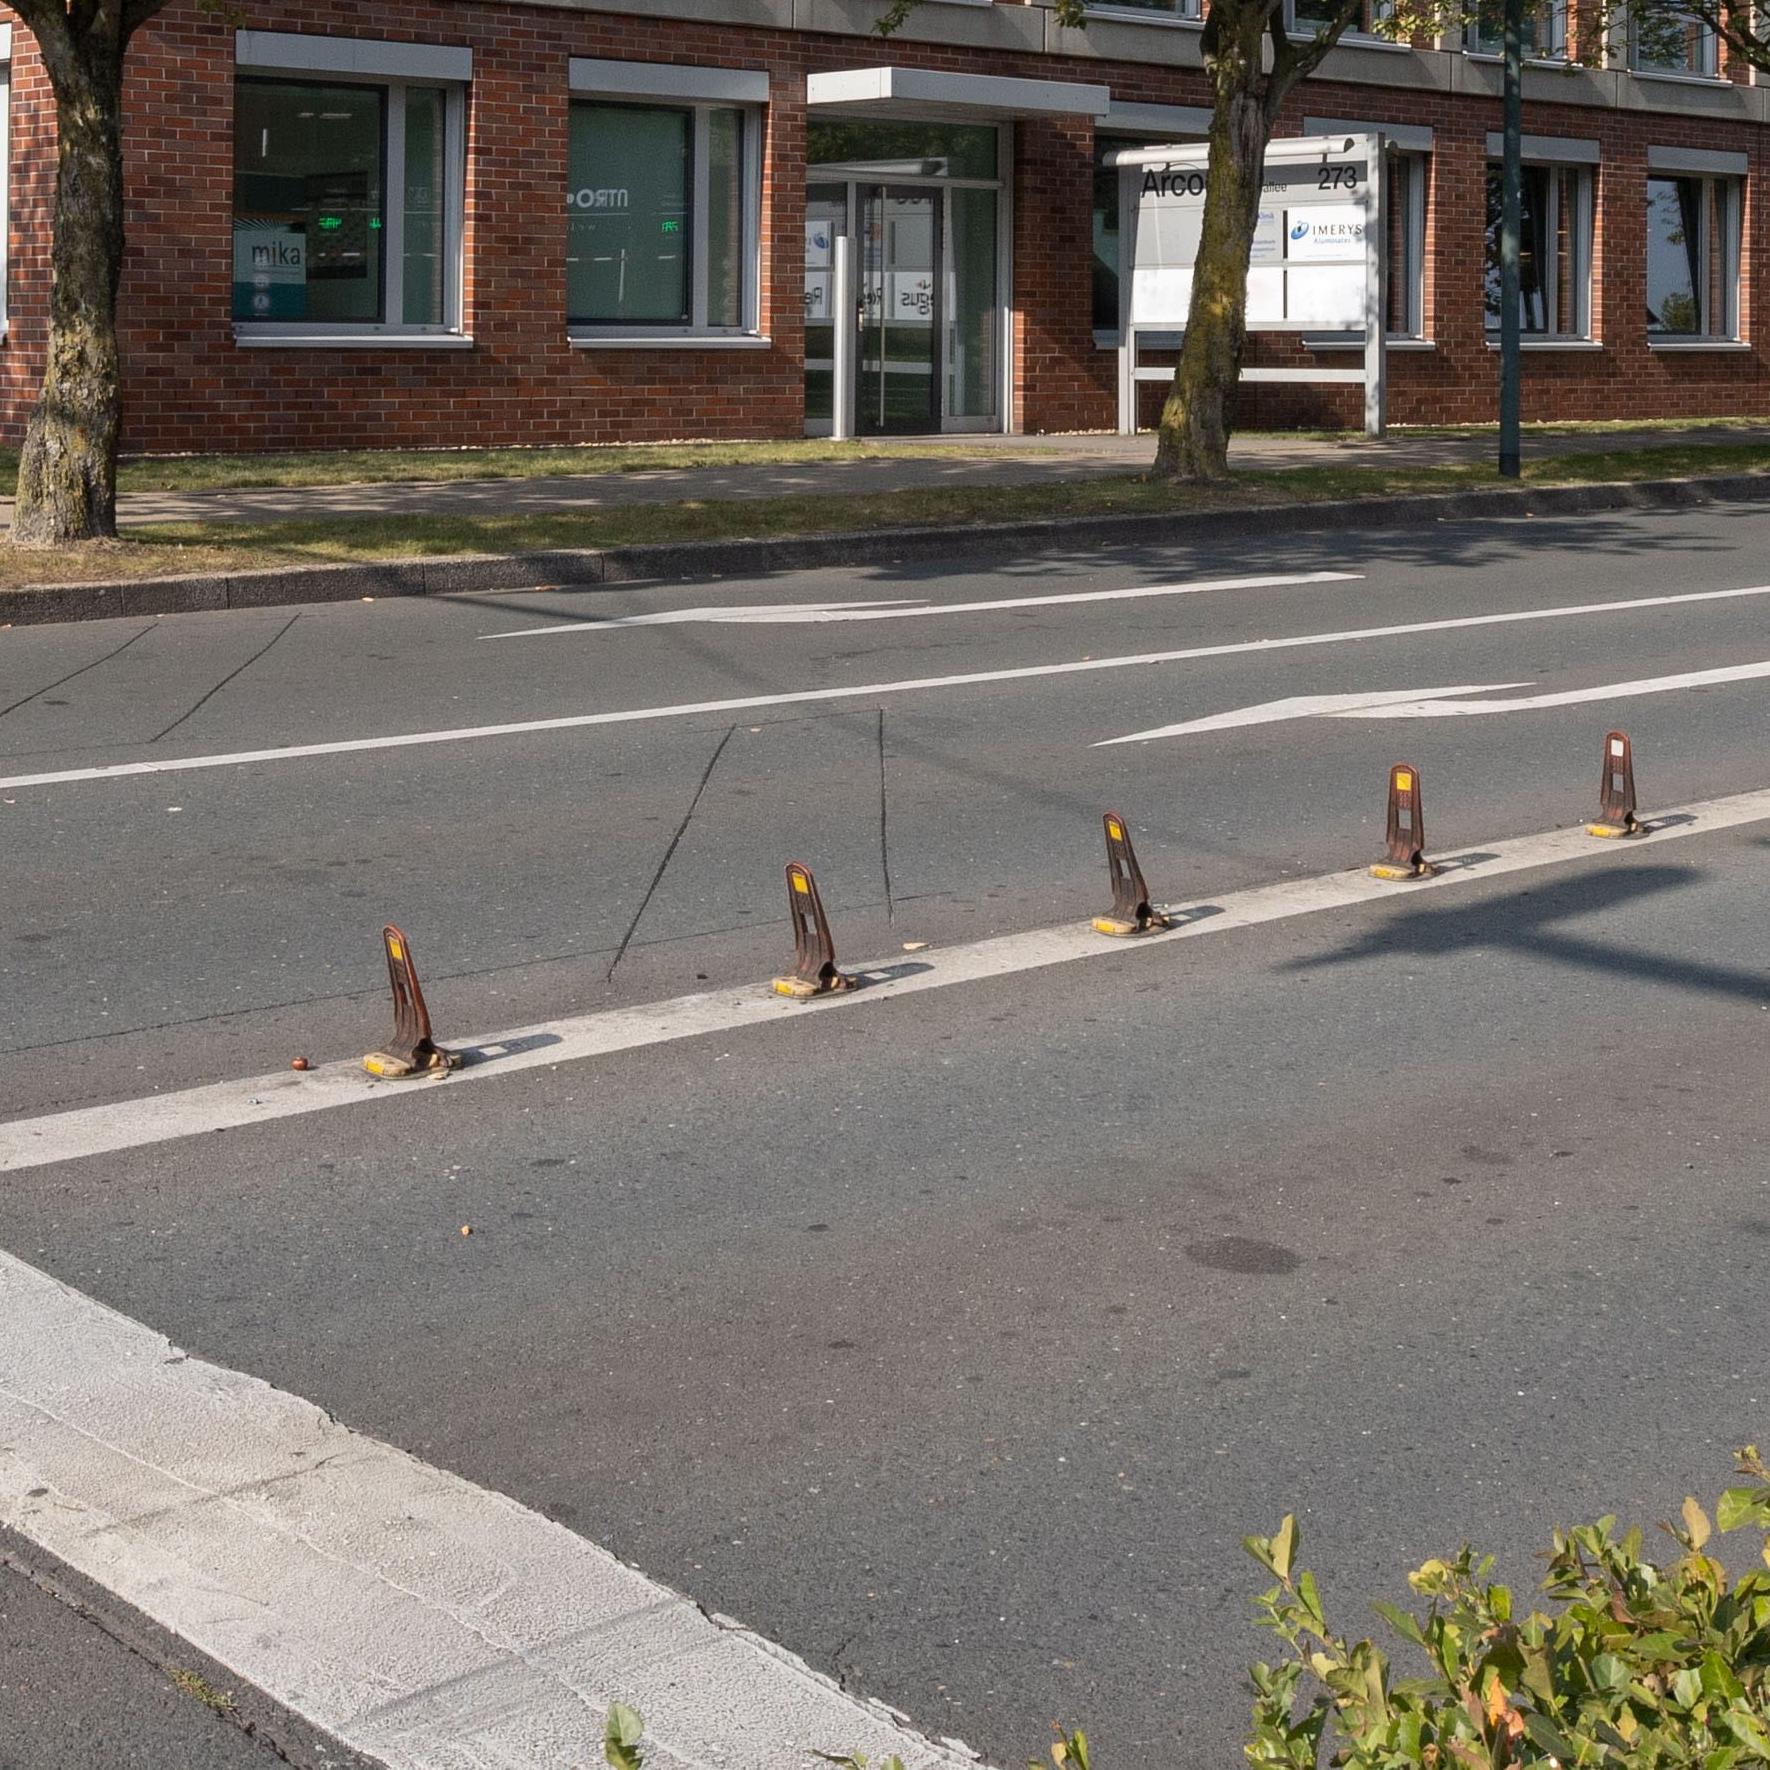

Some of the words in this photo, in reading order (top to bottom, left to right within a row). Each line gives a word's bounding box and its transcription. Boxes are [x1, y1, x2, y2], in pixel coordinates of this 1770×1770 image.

[1141, 169, 1204, 198] Arco
[1318, 166, 1357, 190] 273
[1312, 224, 1363, 236] IMERYS
